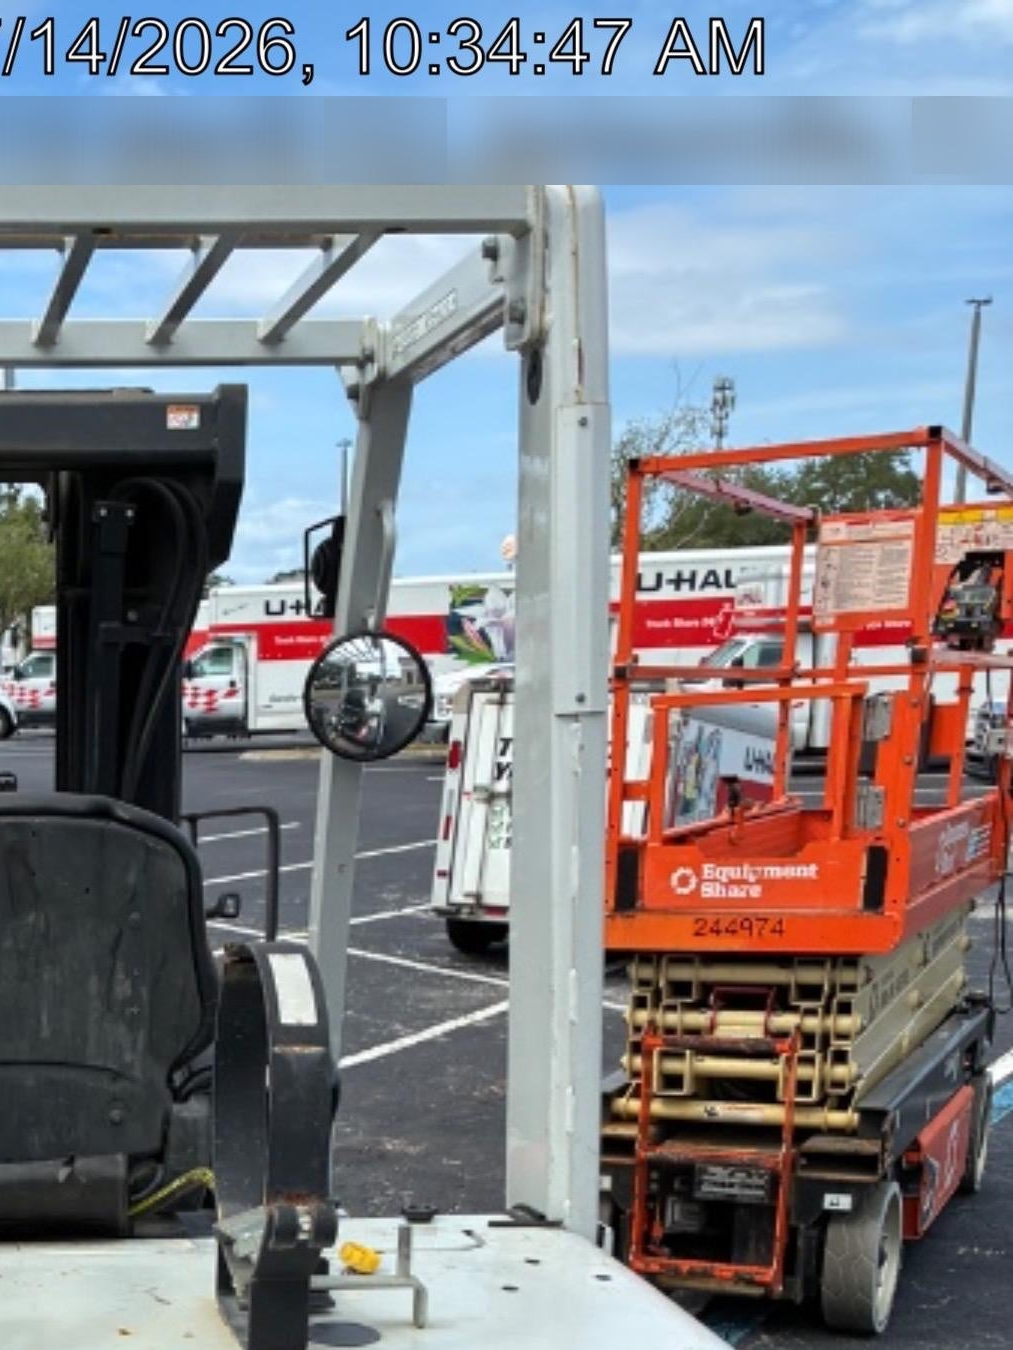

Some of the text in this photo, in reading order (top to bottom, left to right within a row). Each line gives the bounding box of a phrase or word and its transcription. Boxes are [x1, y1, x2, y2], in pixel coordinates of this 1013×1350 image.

[701, 863, 819, 883] Equipment
[701, 882, 763, 898] Share
[692, 917, 786, 938] 244974
